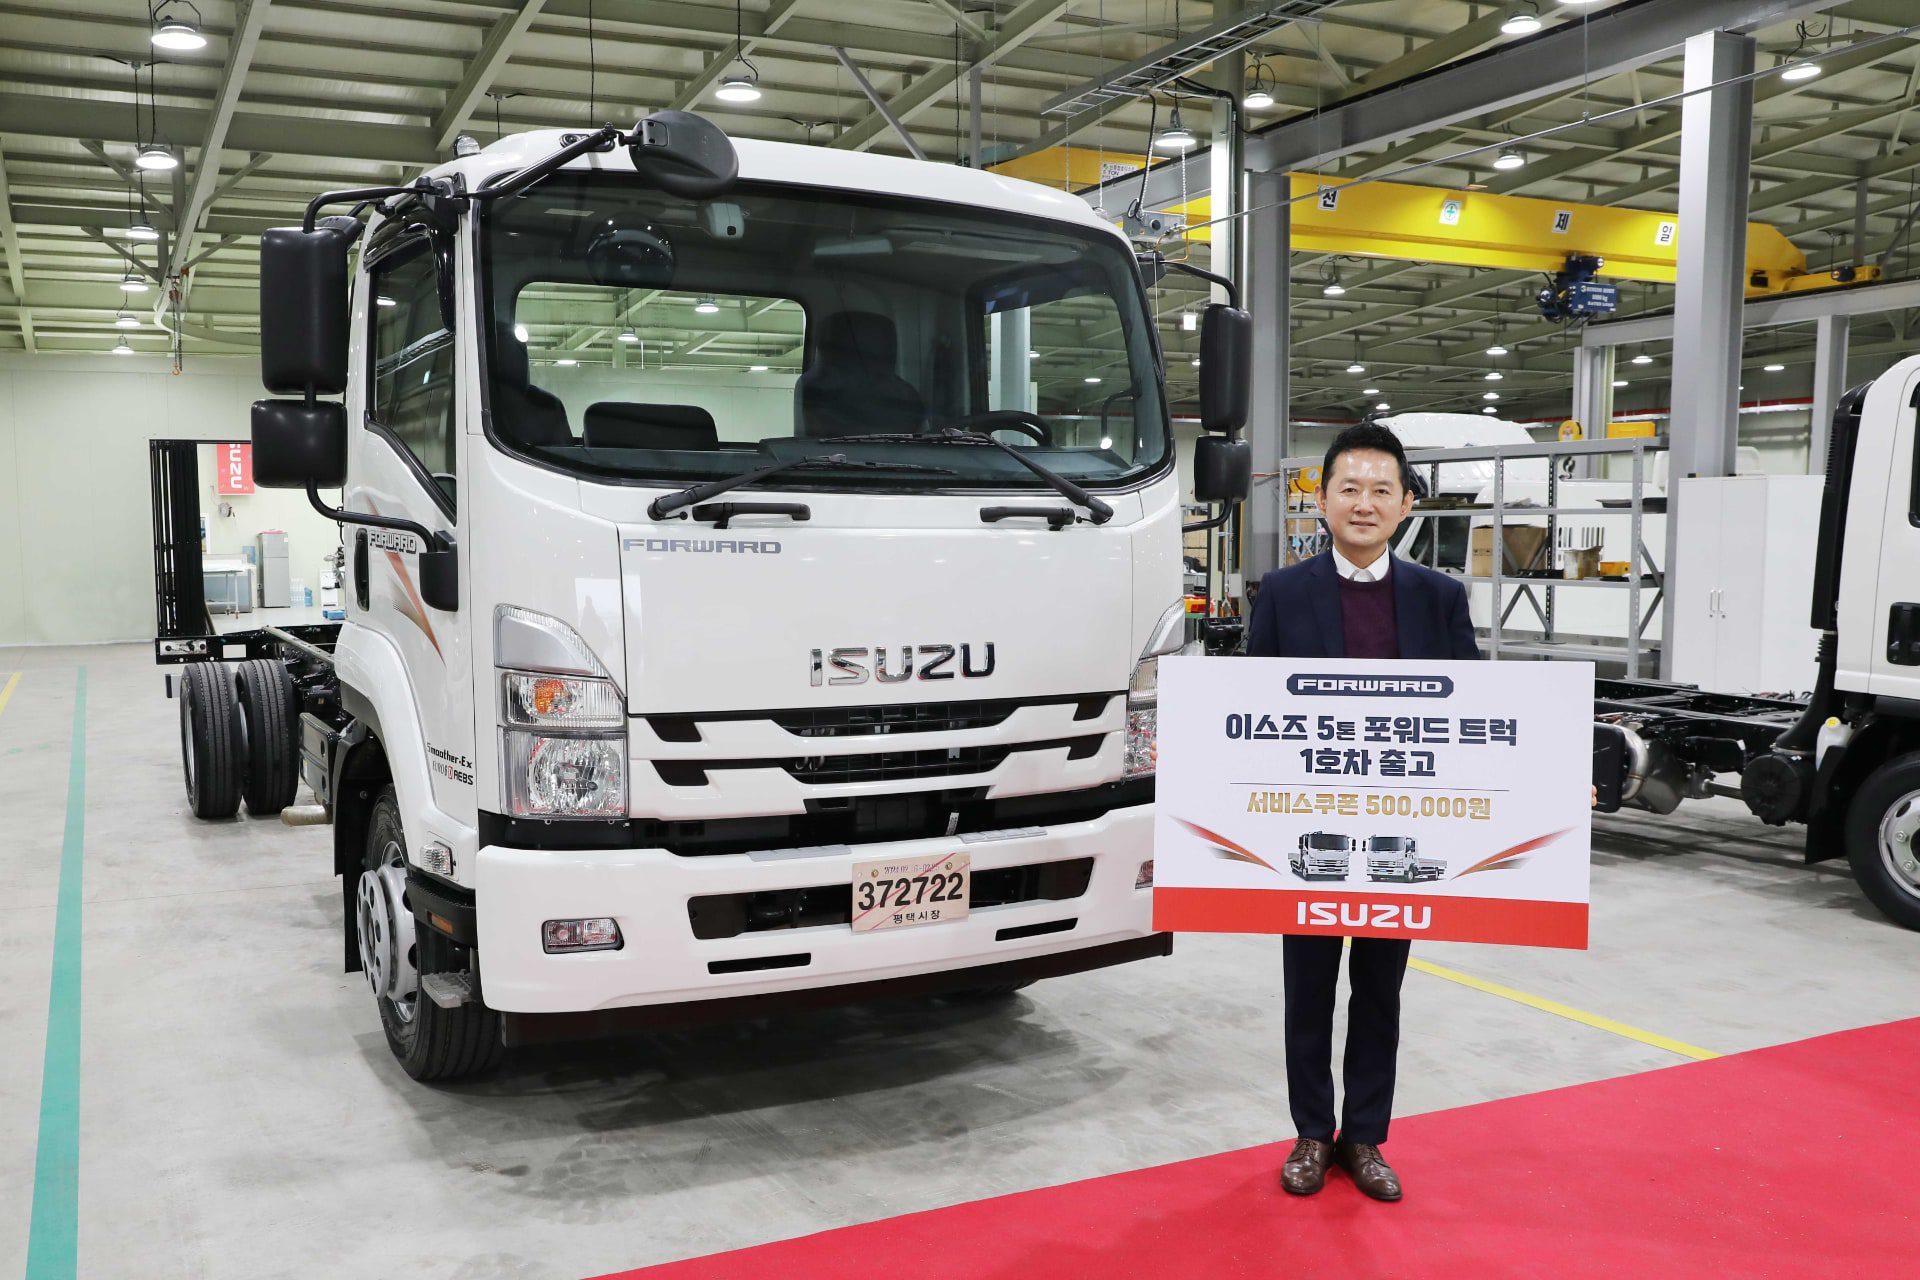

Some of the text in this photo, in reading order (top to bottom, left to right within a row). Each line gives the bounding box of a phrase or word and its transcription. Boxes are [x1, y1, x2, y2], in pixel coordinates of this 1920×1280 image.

[1555, 213, 1570, 231] 제
[1660, 225, 1673, 242] 일
[623, 539, 782, 554] FORWARD
[810, 642, 996, 687] ISUZU
[1297, 679, 1443, 693] FORWARD
[1225, 713, 1517, 746] 이스즈 5톤 포워드 트럭
[1299, 748, 1436, 777] 1호차 출고
[1247, 792, 1491, 820] 서비스쿠폰 500,000원
[858, 872, 964, 911] 372722
[893, 909, 940, 925] 평택시장
[1297, 901, 1432, 929] ISUZU
